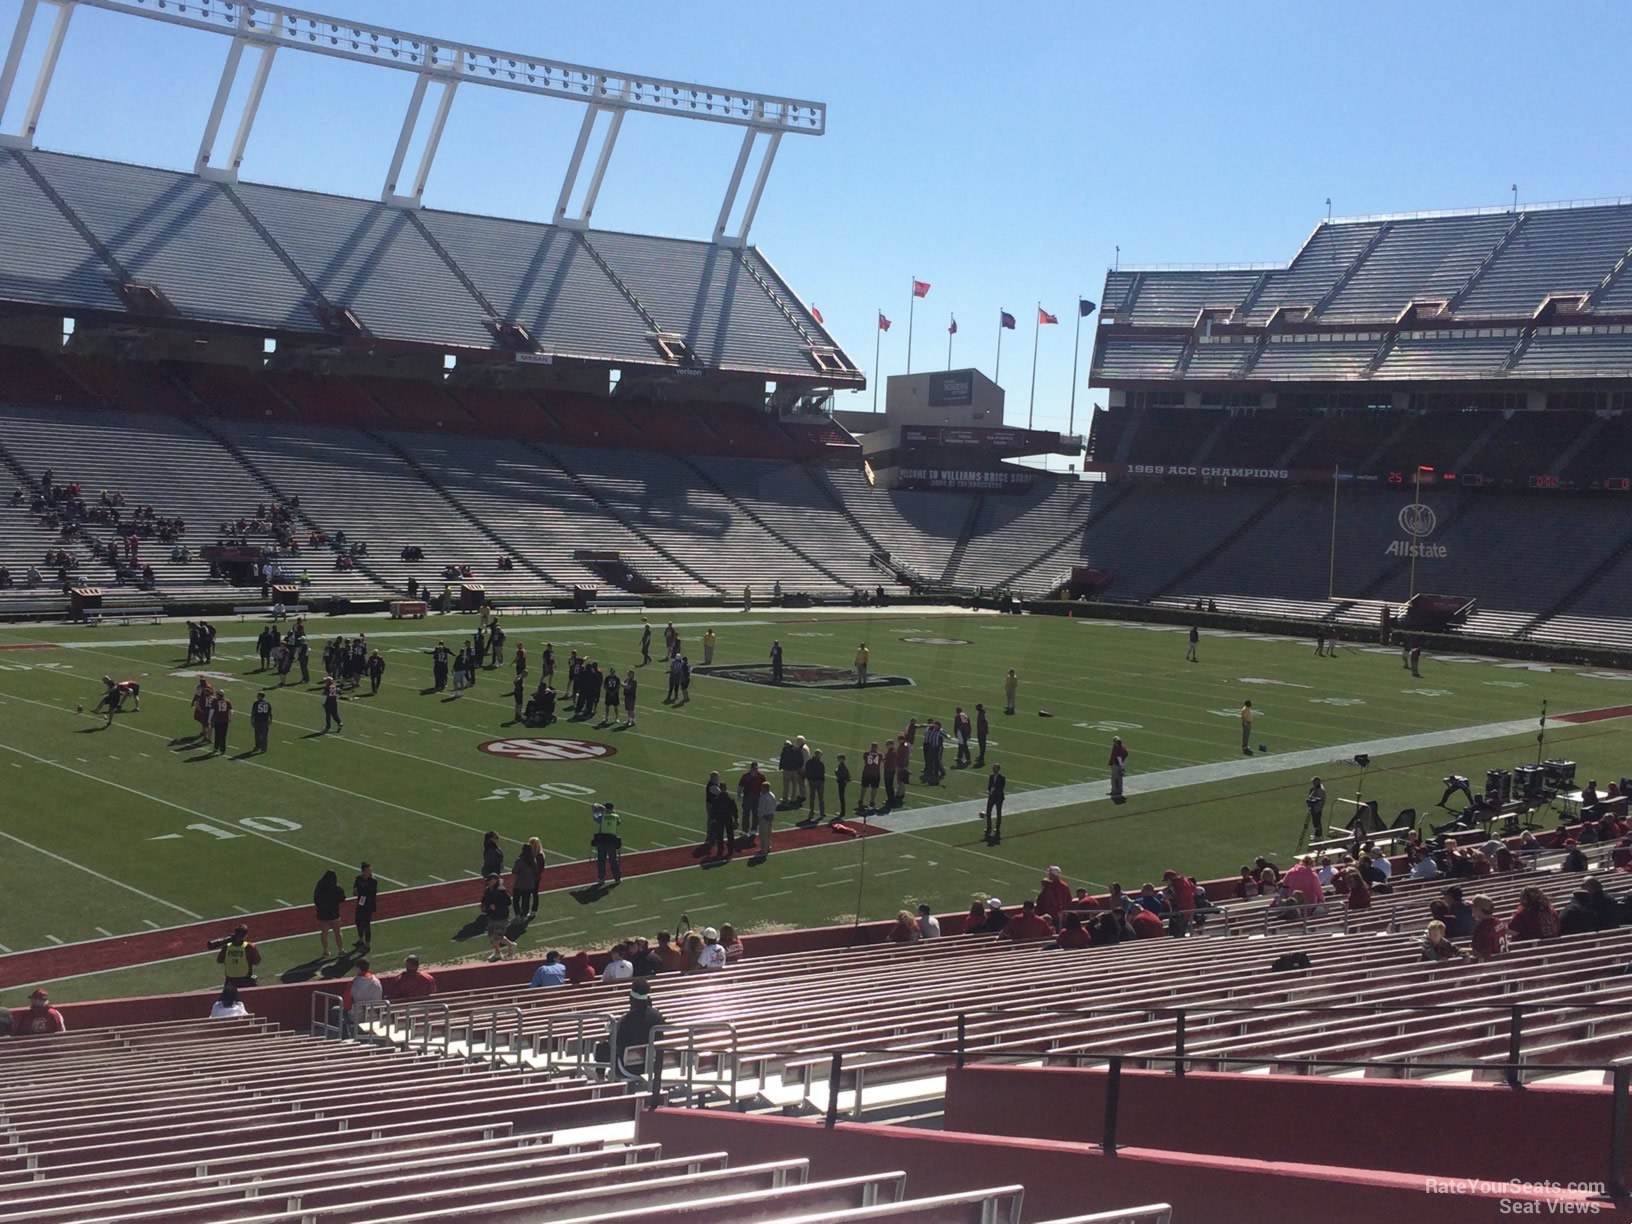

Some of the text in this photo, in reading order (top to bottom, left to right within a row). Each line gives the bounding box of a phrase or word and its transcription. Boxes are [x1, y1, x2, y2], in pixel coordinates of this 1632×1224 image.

[520, 354, 549, 362] NISSAN
[676, 368, 702, 376] verizon
[1127, 464, 1289, 479] 1969 ACC CHAMPIONS
[1384, 540, 1448, 558] Allstate
[257, 703, 269, 713] 50
[492, 782, 597, 803] 20
[185, 816, 303, 841] 10
